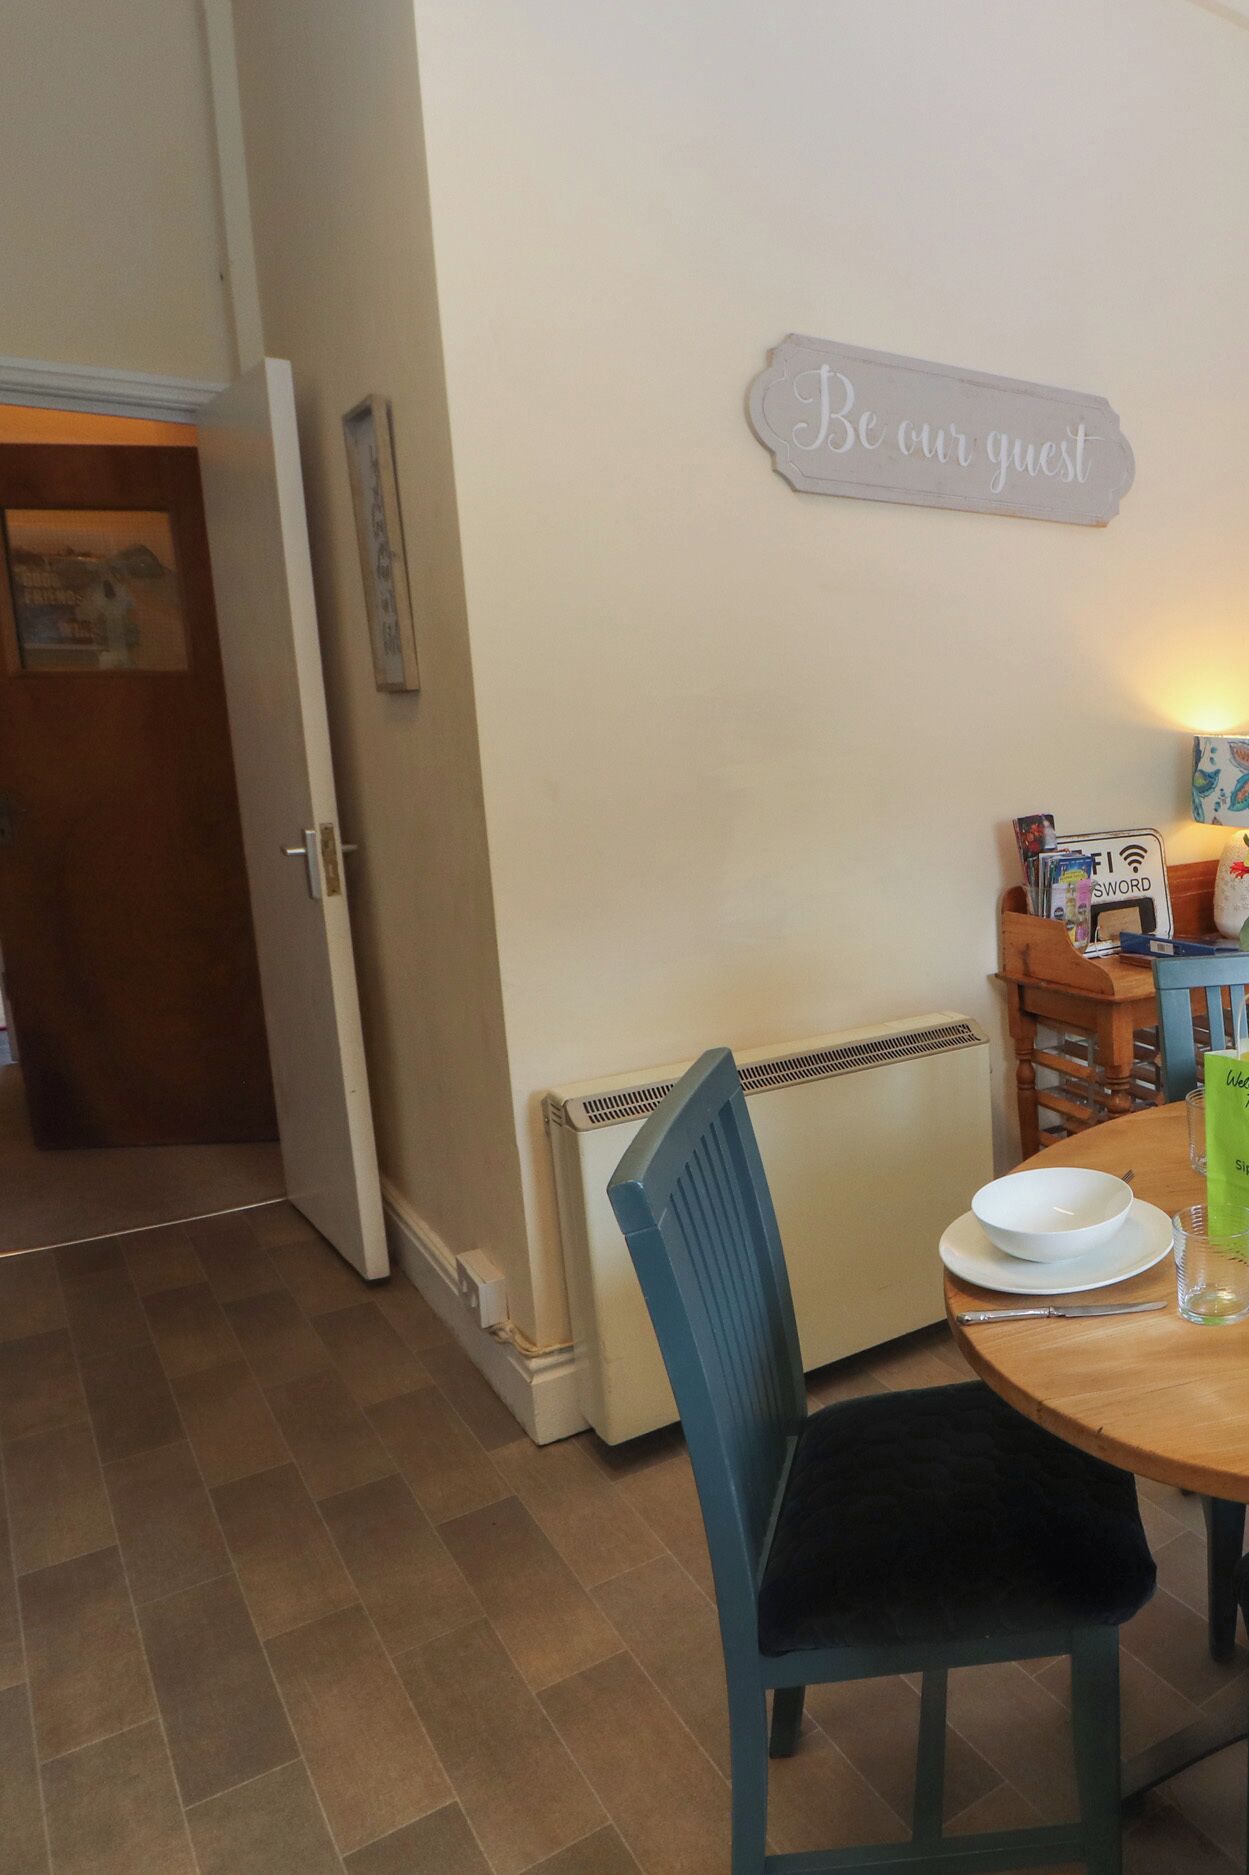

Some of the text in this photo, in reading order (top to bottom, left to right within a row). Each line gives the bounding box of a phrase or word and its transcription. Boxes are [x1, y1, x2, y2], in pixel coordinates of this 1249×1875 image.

[791, 363, 1103, 494] Be our guest
